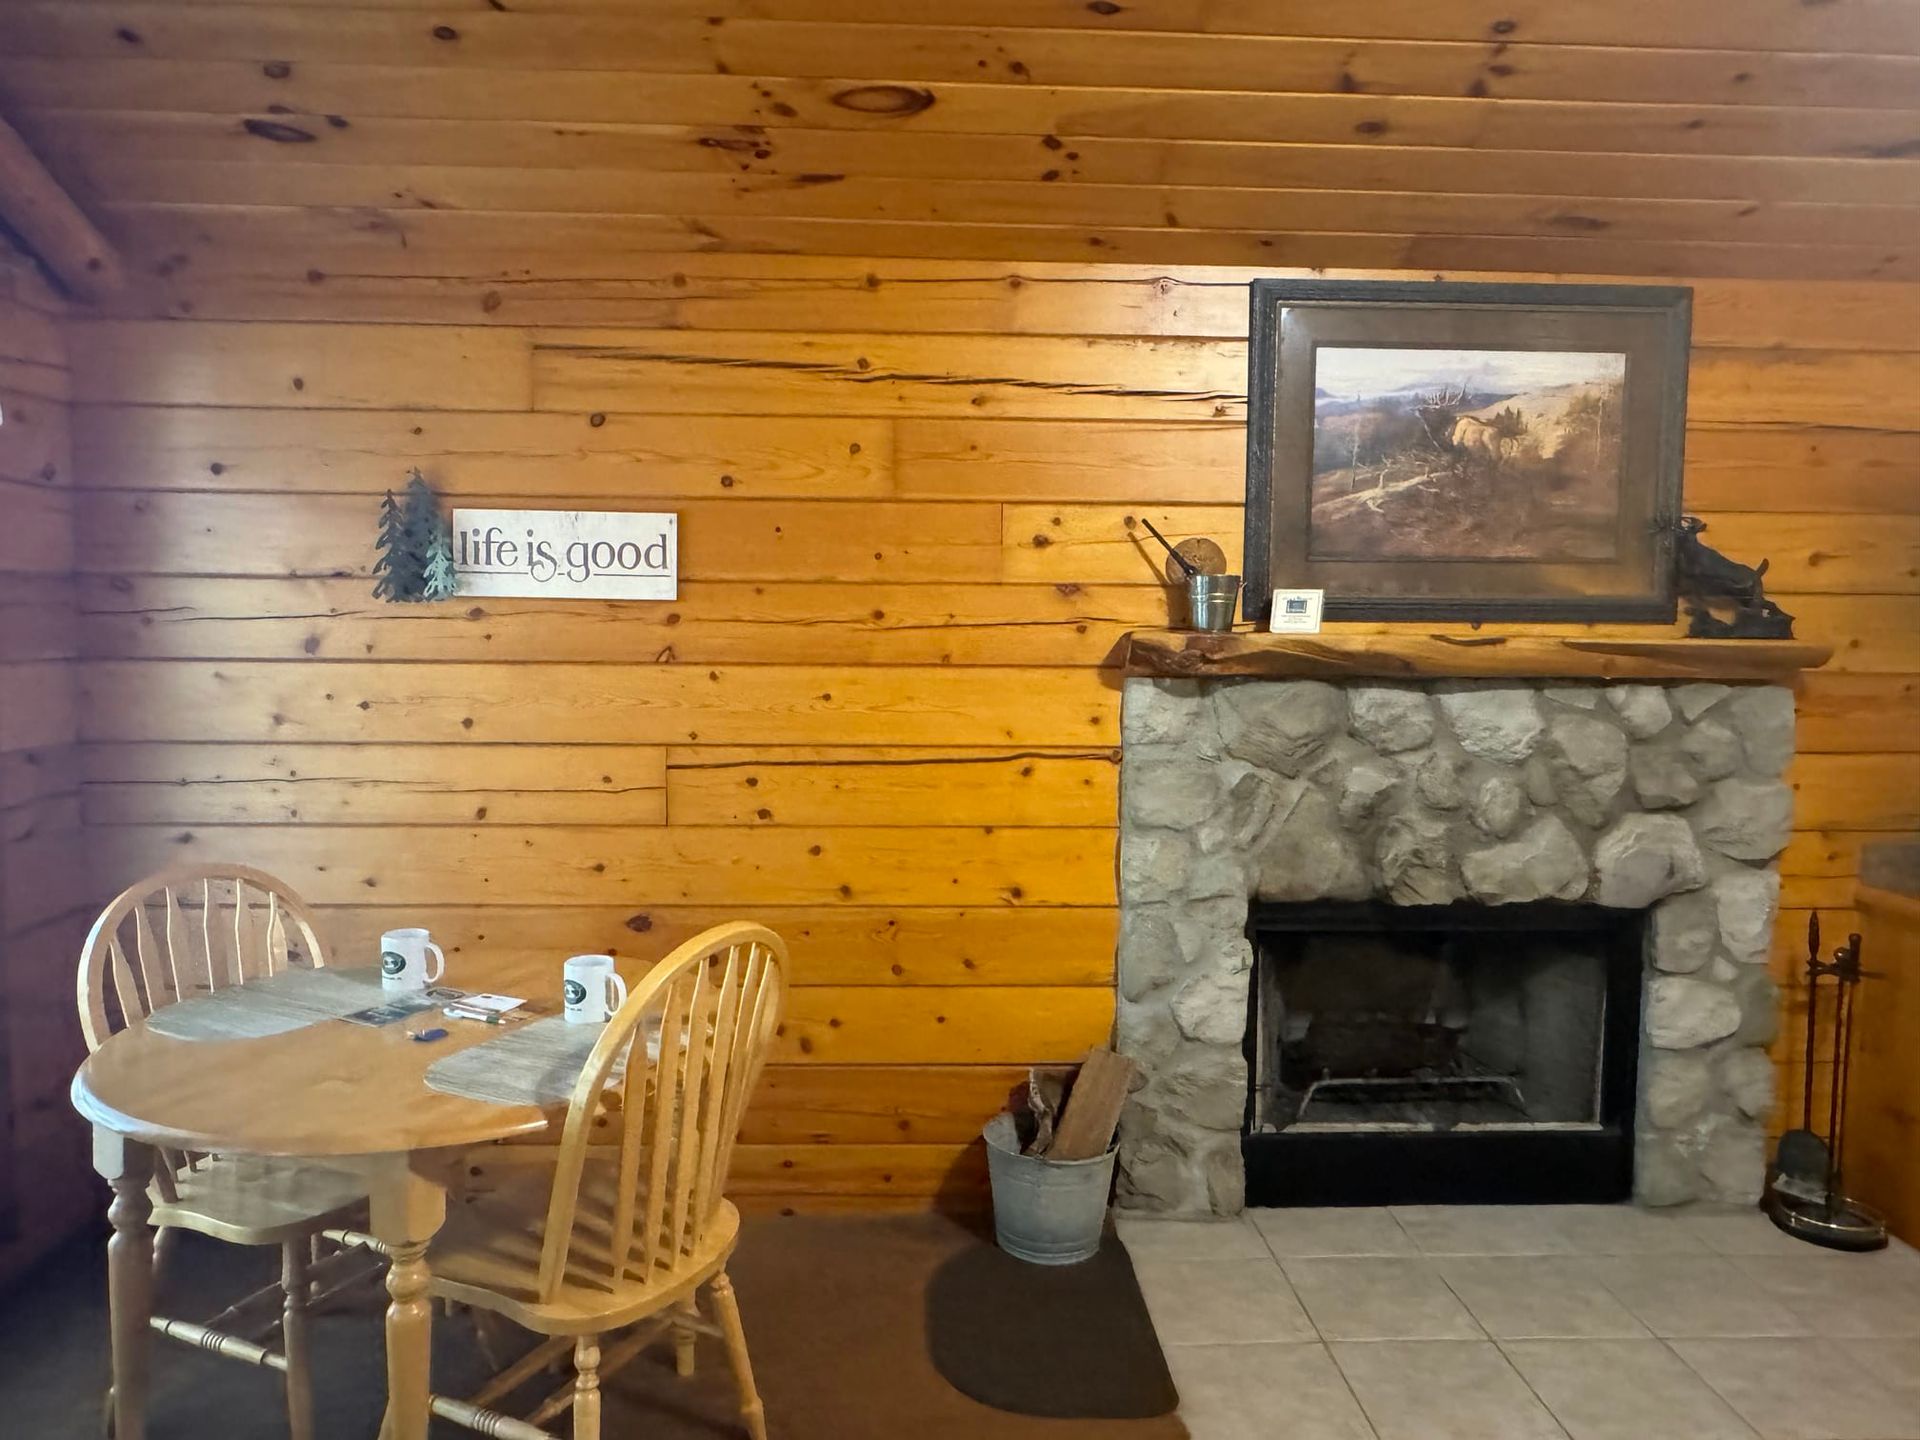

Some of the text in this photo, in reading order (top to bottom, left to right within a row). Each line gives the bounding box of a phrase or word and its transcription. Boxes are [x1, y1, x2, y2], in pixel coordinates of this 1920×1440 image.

[460, 527, 668, 582] life is good
